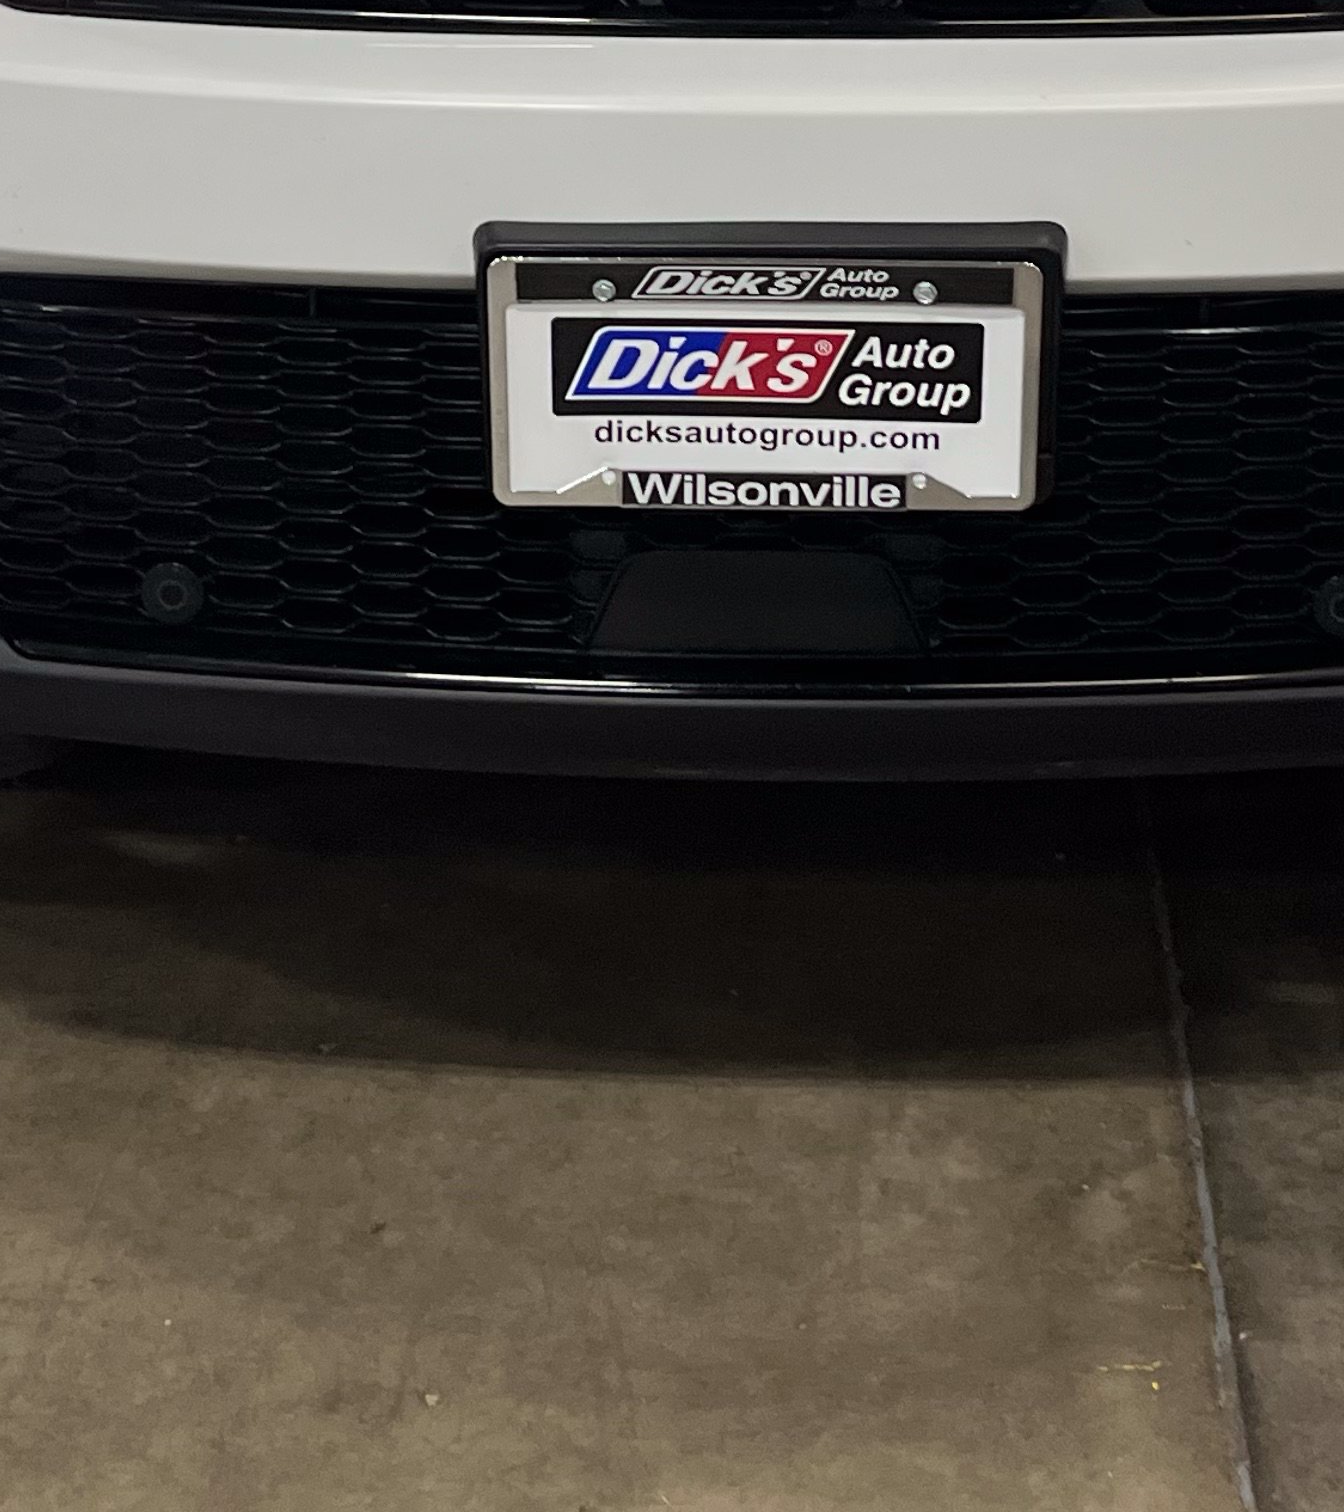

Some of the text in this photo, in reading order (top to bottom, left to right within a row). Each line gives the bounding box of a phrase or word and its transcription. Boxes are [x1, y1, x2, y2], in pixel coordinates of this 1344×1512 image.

[645, 268, 890, 296] Dick's Auto
[819, 283, 899, 301] Group
[587, 335, 956, 392] Dick's Auto
[838, 374, 972, 416] Group
[594, 420, 941, 453] dicksautogroup.com
[627, 472, 902, 508] Wilsonville
